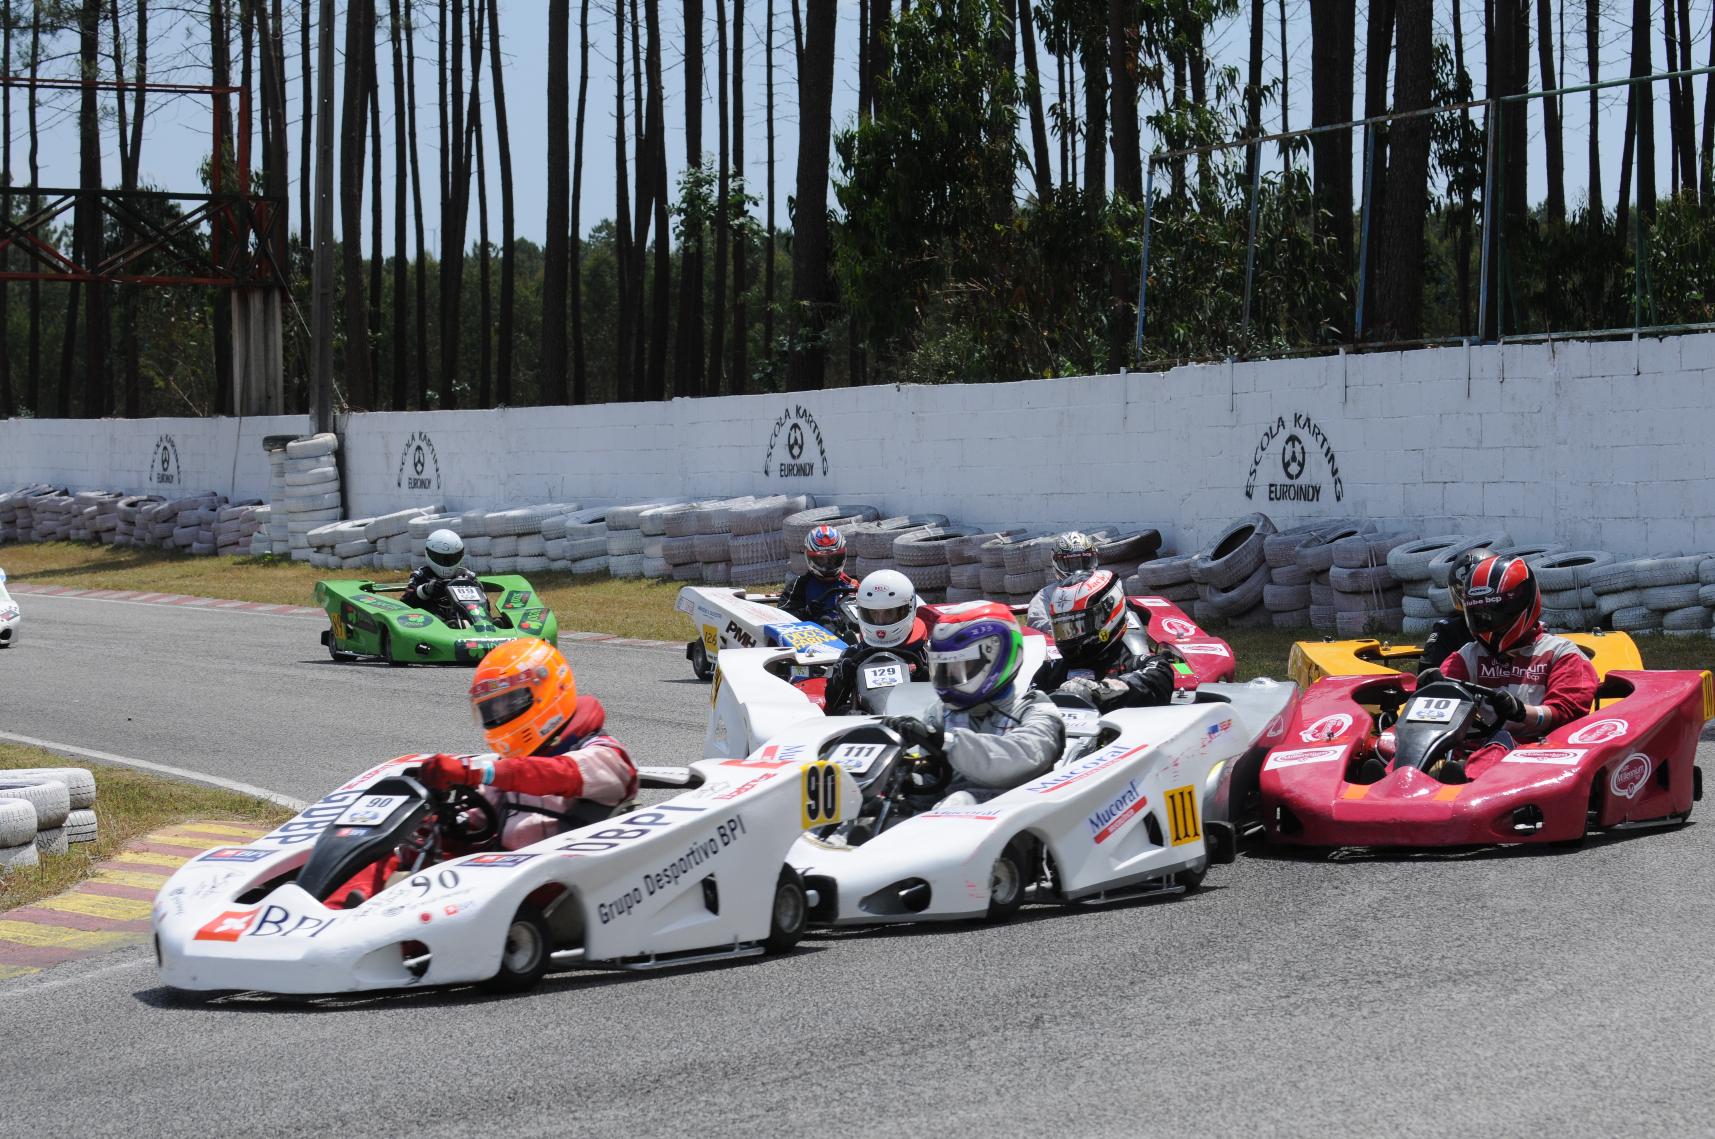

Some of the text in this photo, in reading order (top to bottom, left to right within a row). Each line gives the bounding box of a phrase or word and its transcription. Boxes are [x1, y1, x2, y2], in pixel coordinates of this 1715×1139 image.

[764, 404, 828, 477] ESCOLA KARTING
[1245, 412, 1343, 502] ESCOLA KARTING
[779, 462, 815, 478] EUROINDY
[1268, 483, 1321, 502] EUROINDY
[870, 667, 897, 677] 129
[1423, 698, 1452, 710] 10
[844, 745, 877, 758] 111
[1025, 744, 1132, 791] Mucoral
[366, 797, 394, 808] 90
[808, 764, 836, 821] 90
[1088, 779, 1140, 834] Mucoral
[1169, 789, 1201, 842] 111
[411, 869, 460, 898] 90
[597, 813, 747, 926] Grupo Desportivo BPI
[246, 904, 337, 938] BPI
